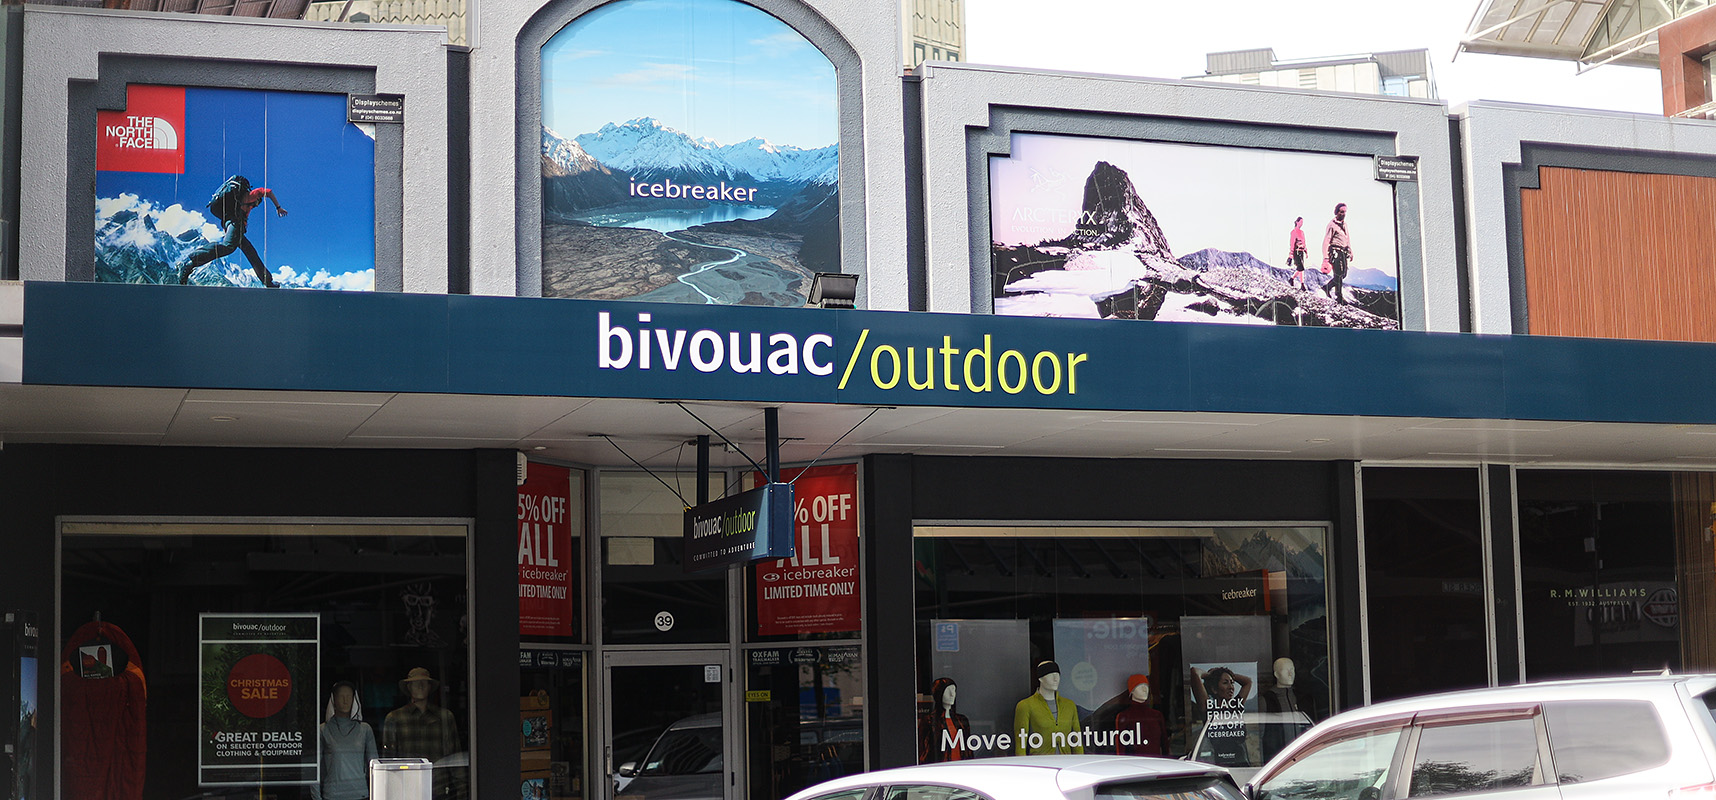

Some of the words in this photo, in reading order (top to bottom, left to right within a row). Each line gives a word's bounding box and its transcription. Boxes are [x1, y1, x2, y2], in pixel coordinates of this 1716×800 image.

[354, 99, 399, 107] Displayschemes
[126, 115, 153, 127] THE
[105, 125, 153, 138] NORTH
[119, 137, 153, 149] FACE
[629, 177, 758, 202] icebreaker
[597, 310, 1089, 396] bivouac/outdoor
[541, 495, 566, 524] OFF
[811, 493, 852, 523] OFF
[693, 506, 757, 540] bivouac/outdoor
[518, 522, 559, 568] ALL
[693, 550, 719, 562] COMMITTED
[720, 548, 727, 556] TO
[727, 541, 756, 554] ADVENTURE
[522, 566, 567, 582] icebreaker
[783, 566, 855, 582] icebreaker
[536, 586, 551, 599] TIME
[552, 587, 567, 600] ONLY
[764, 584, 803, 600] LIMITED
[804, 583, 829, 598] TIME
[829, 581, 855, 597] ONLY
[1221, 587, 1257, 600] icebreaker
[232, 622, 287, 632] bivouac/outdoor
[656, 615, 673, 627] 39
[752, 650, 780, 658] OXFAM
[230, 679, 289, 688] CHRISTMAS
[240, 688, 279, 700] SALE
[1206, 698, 1245, 709] BLACK
[1207, 709, 1245, 720] FRIDAY
[1208, 721, 1225, 730] 25%
[1227, 720, 1245, 730] OFF
[216, 732, 258, 743] GREAT
[262, 731, 303, 742] DEALS
[940, 727, 1012, 752] Move
[1018, 727, 1044, 750] to
[1051, 721, 1149, 748] natural.
[1207, 730, 1245, 738] ICEBREAKER
[230, 742, 265, 750] SELECTED
[216, 749, 252, 757] CLOTHING
[261, 749, 303, 757] EQUIPMENT
